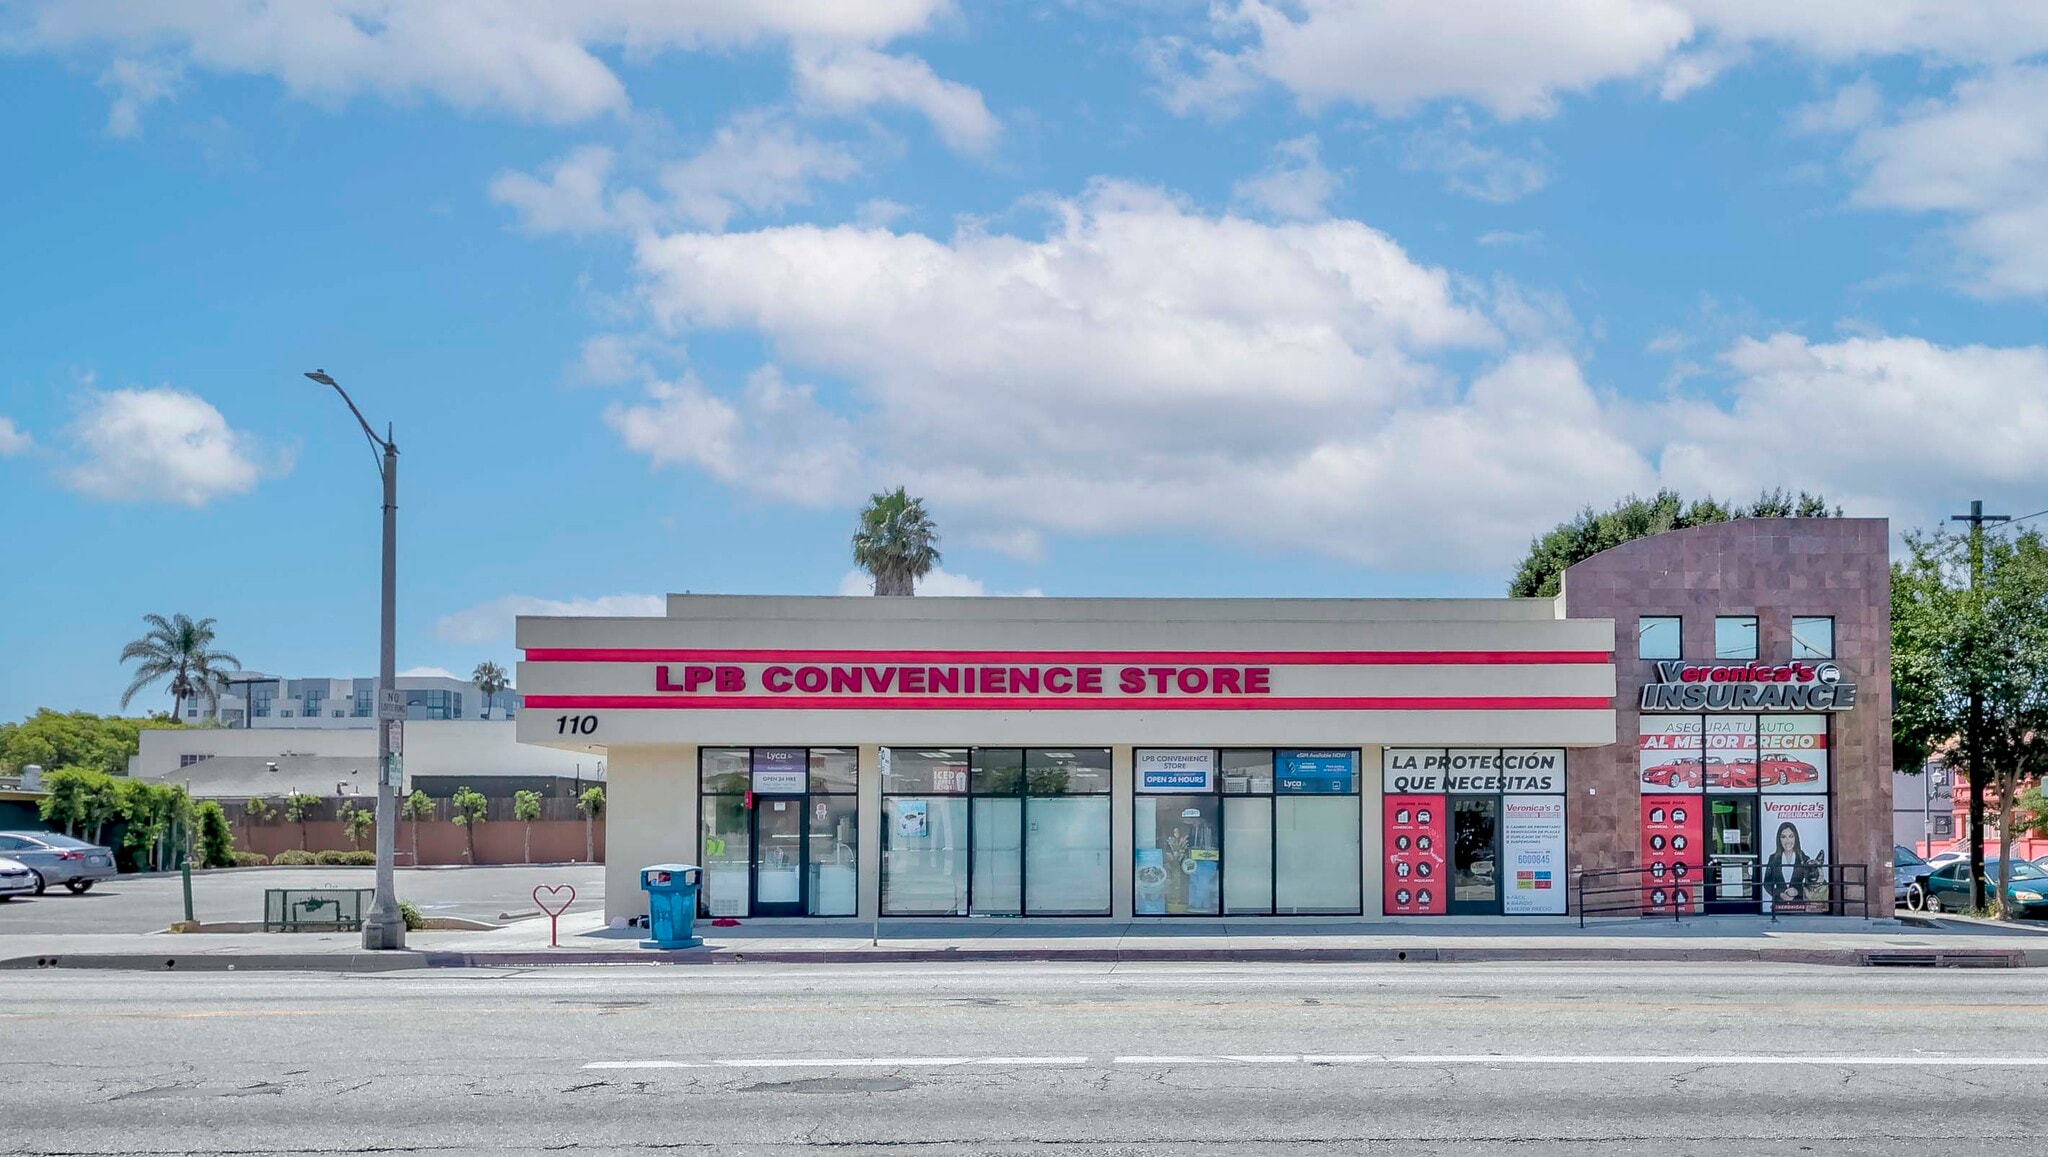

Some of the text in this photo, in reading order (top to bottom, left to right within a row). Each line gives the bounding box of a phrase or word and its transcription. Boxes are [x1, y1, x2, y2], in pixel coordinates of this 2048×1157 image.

[1657, 661, 1815, 683] Veronica's
[656, 665, 1270, 694] LPB CONVENIENCE STORE
[387, 693, 400, 703] NO
[1641, 684, 1857, 710] INSURANCE
[556, 715, 598, 735] 110
[1665, 722, 1795, 733] ASEGURA TU AUTO
[1644, 735, 1815, 749] AL MEJOR PRECIO
[766, 751, 787, 761] Lyca
[1392, 752, 1555, 769] LA PROTECCIÓN
[933, 770, 955, 780] ICED
[1283, 779, 1302, 788] Lyca
[1394, 776, 1553, 793] QUE NECESITAS
[1506, 803, 1551, 812] Veronica's
[1763, 801, 1825, 812] Veronica's
[1777, 811, 1824, 819] INSURANCE
